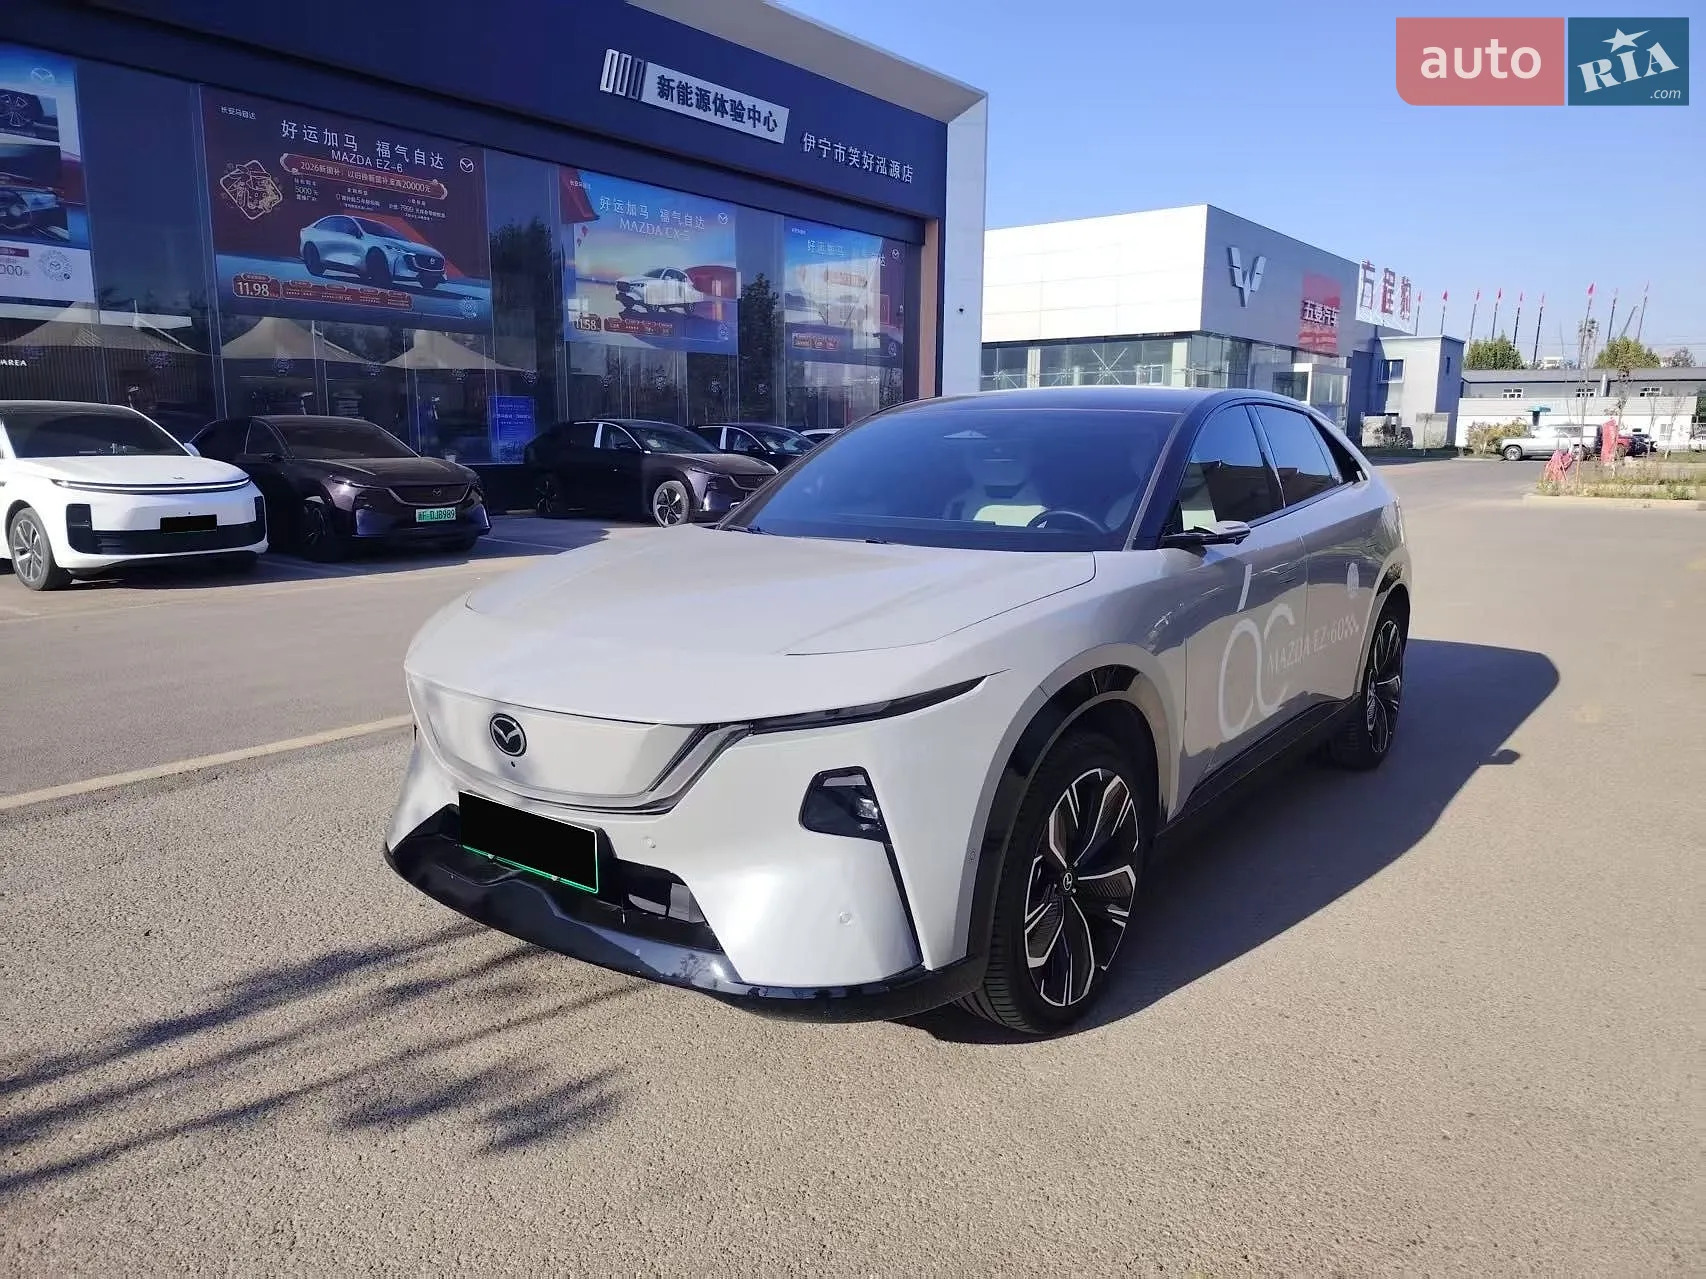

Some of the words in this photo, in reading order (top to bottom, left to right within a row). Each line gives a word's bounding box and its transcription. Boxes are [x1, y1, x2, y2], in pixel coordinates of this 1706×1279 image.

[657, 74, 778, 133] 新能源体验中心
[280, 119, 358, 152] 好运加马
[375, 140, 445, 170] 福气自达
[802, 131, 914, 184] 伊宁市笑好泓源店
[331, 150, 373, 168] MAZDA
[375, 158, 403, 173] EZ-6
[599, 196, 649, 220] 好运加马
[658, 207, 705, 230] 福气自达
[619, 218, 662, 237] MAZDA
[237, 281, 270, 297] 11.98
[1302, 299, 1340, 327] 五菱汽车
